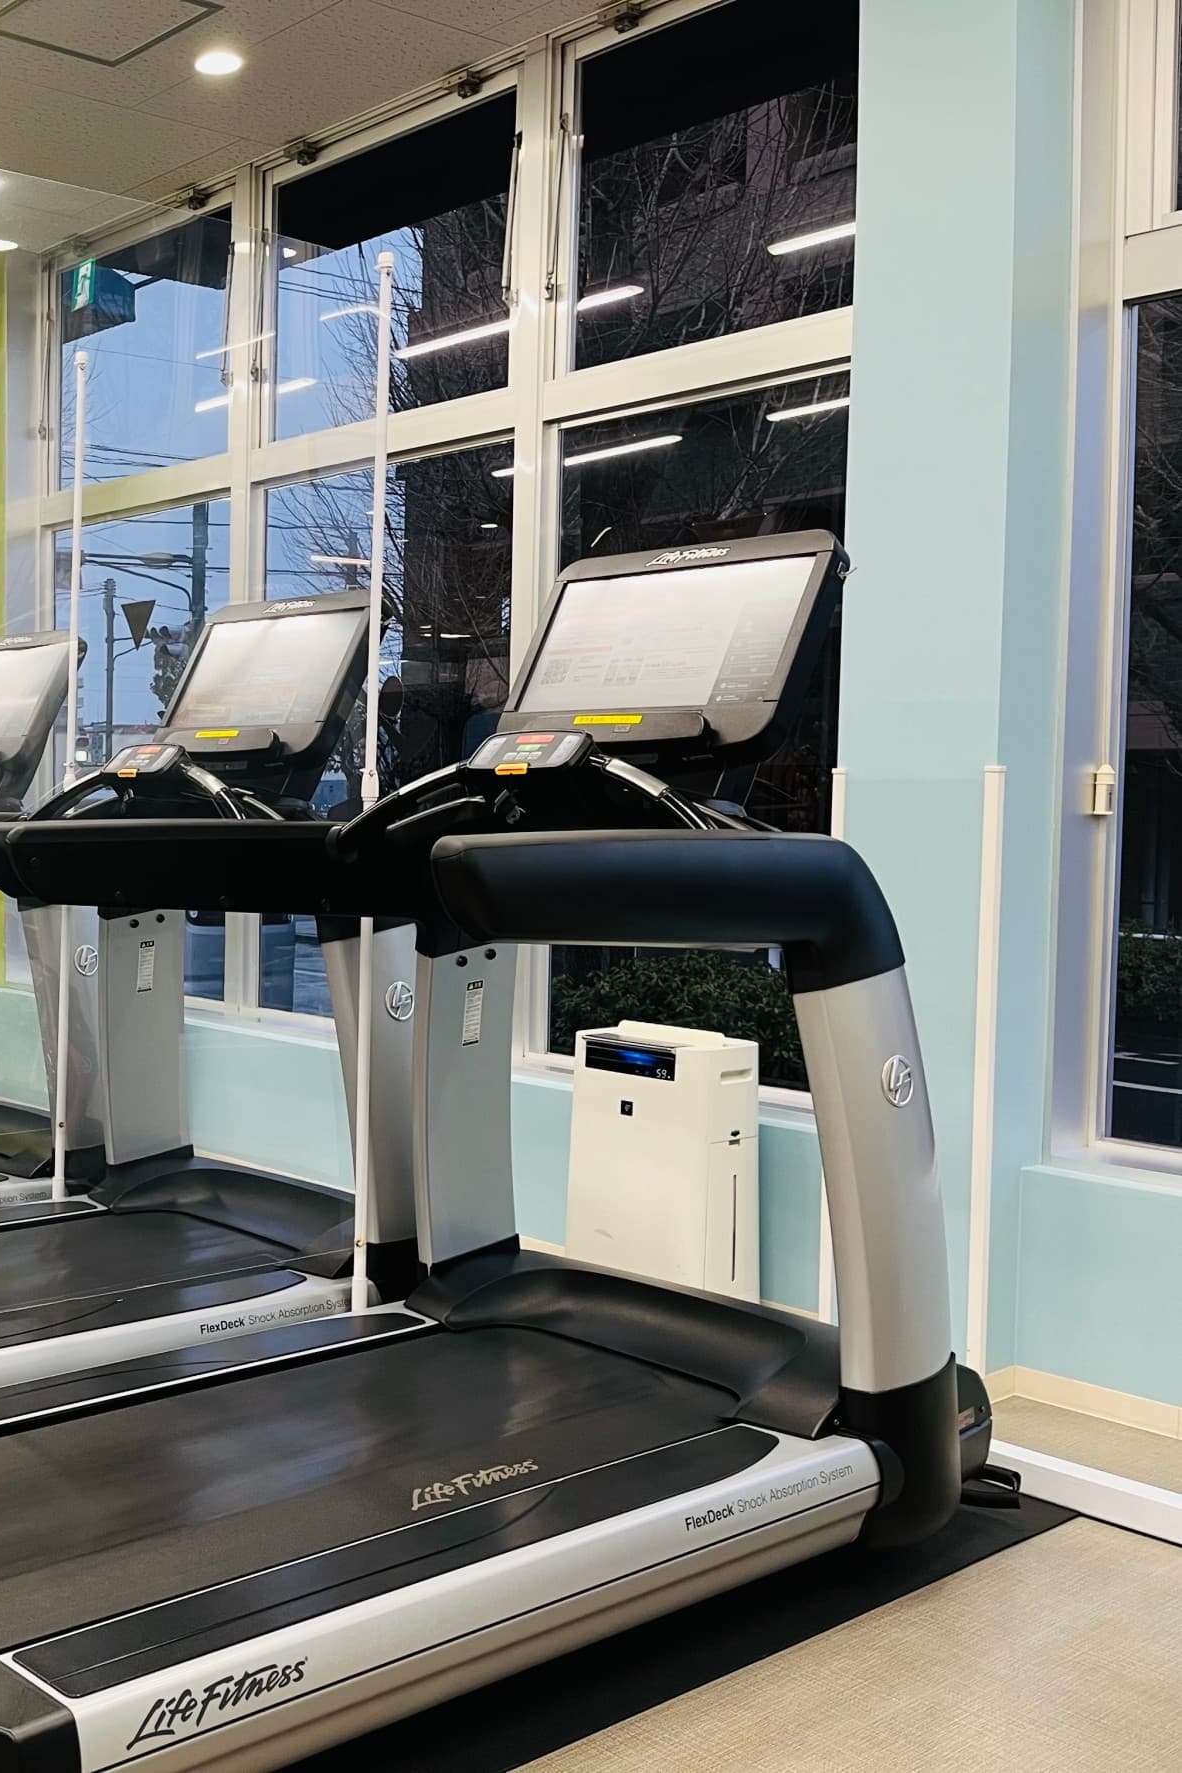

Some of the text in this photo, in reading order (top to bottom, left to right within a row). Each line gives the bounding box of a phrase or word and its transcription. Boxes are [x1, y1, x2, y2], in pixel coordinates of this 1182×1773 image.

[200, 1318, 246, 1335] FlexDeck
[248, 1312, 276, 1326] Shock
[278, 1303, 325, 1319] Absorption
[685, 1464, 854, 1531] FlexDeck Shock Absorption System
